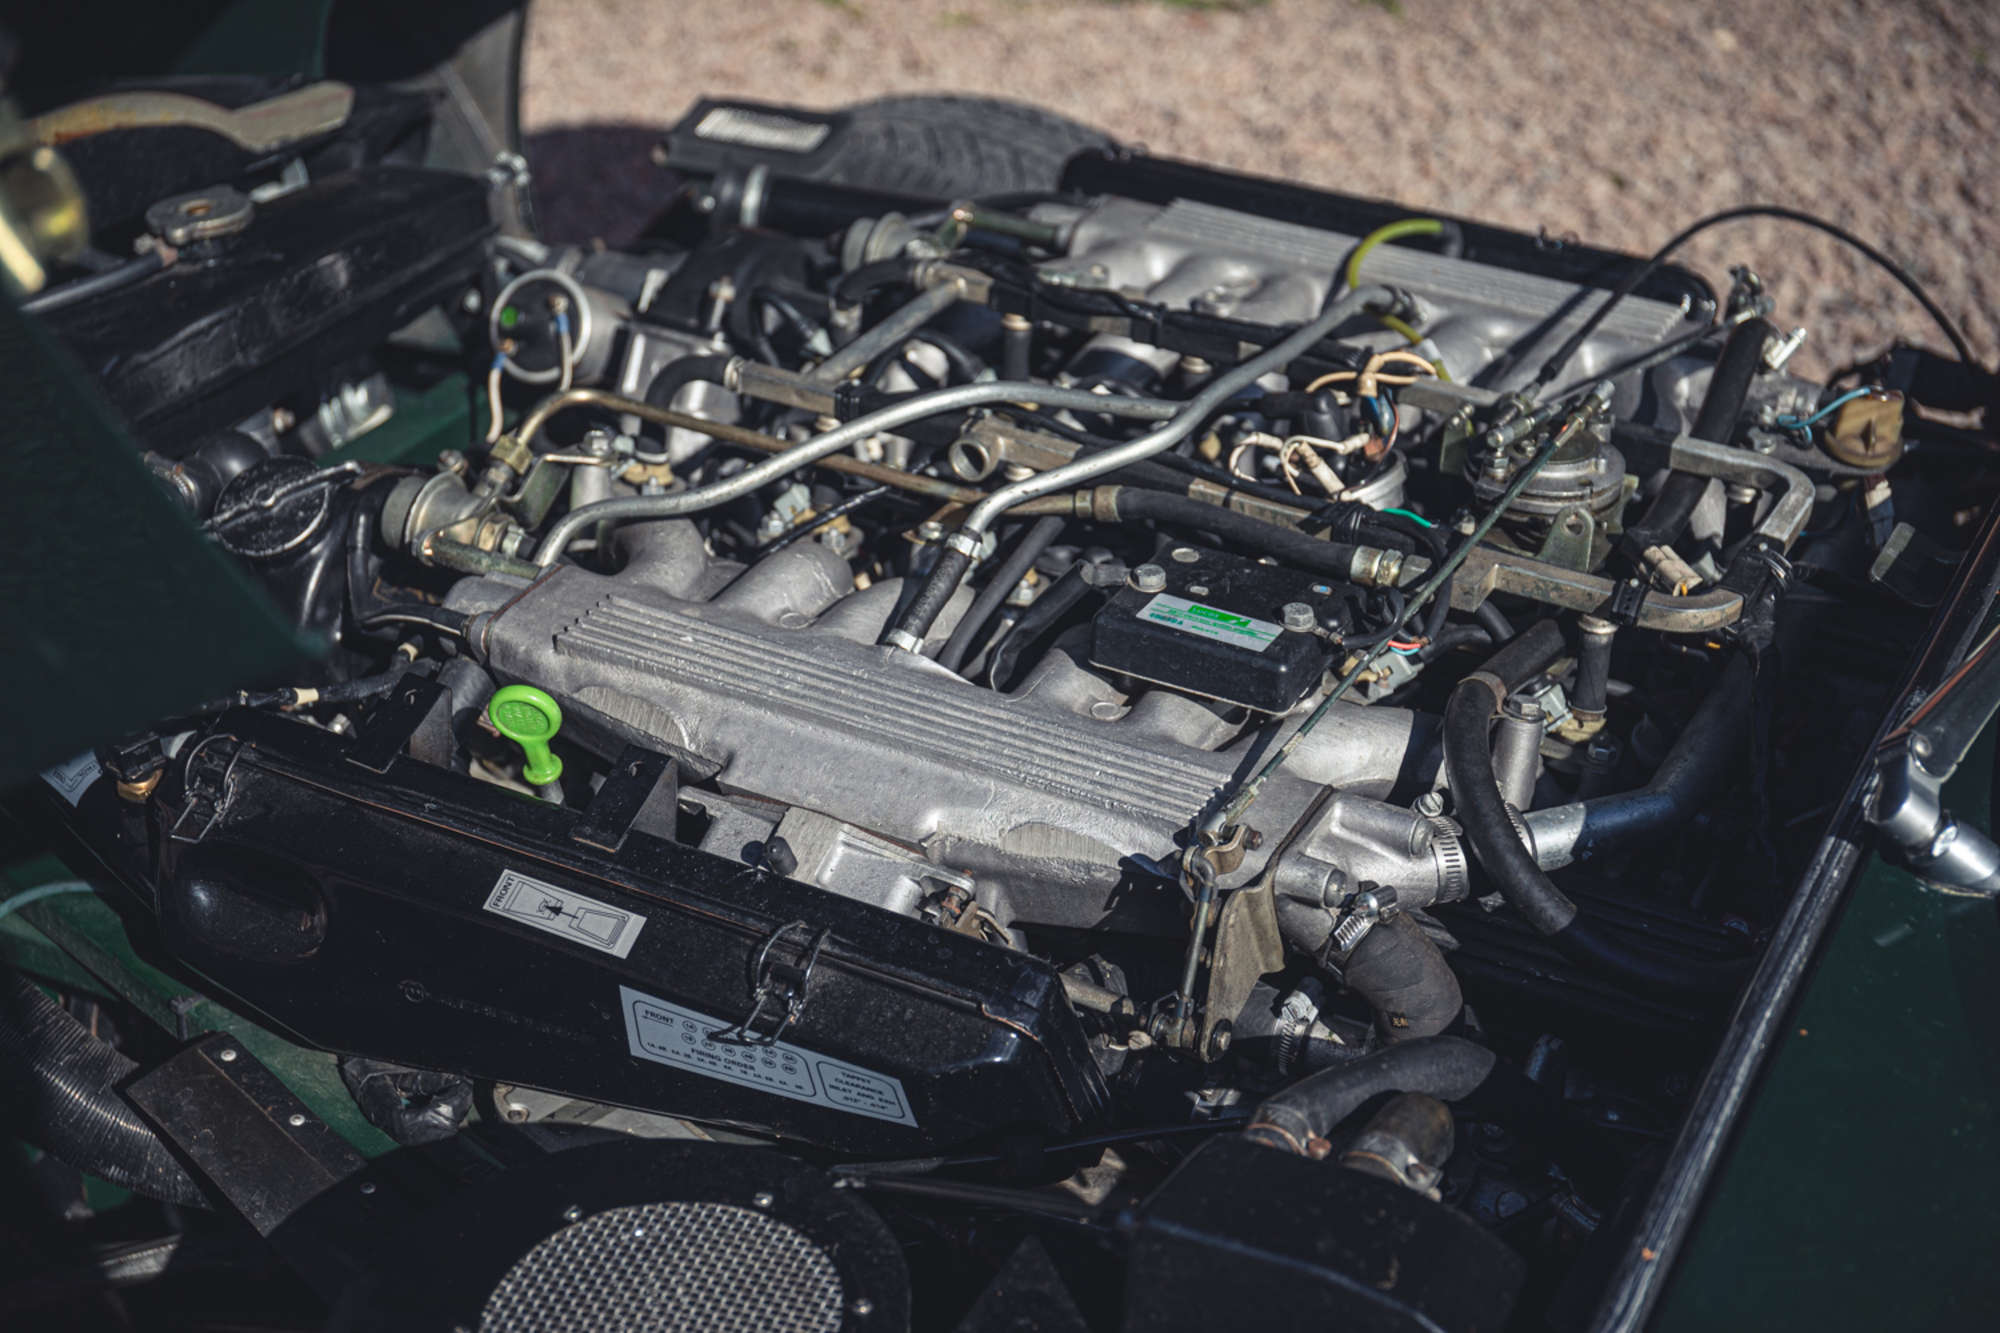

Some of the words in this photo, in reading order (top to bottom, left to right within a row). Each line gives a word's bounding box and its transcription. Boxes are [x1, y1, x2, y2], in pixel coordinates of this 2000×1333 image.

[492, 876, 515, 908] FRONT
[644, 1009, 674, 1024] FRONT
[691, 1048, 722, 1062] FIRING
[723, 1058, 756, 1071] ORDER
[841, 1071, 872, 1084] TAPPET
[834, 1078, 884, 1095] CLEARANCE
